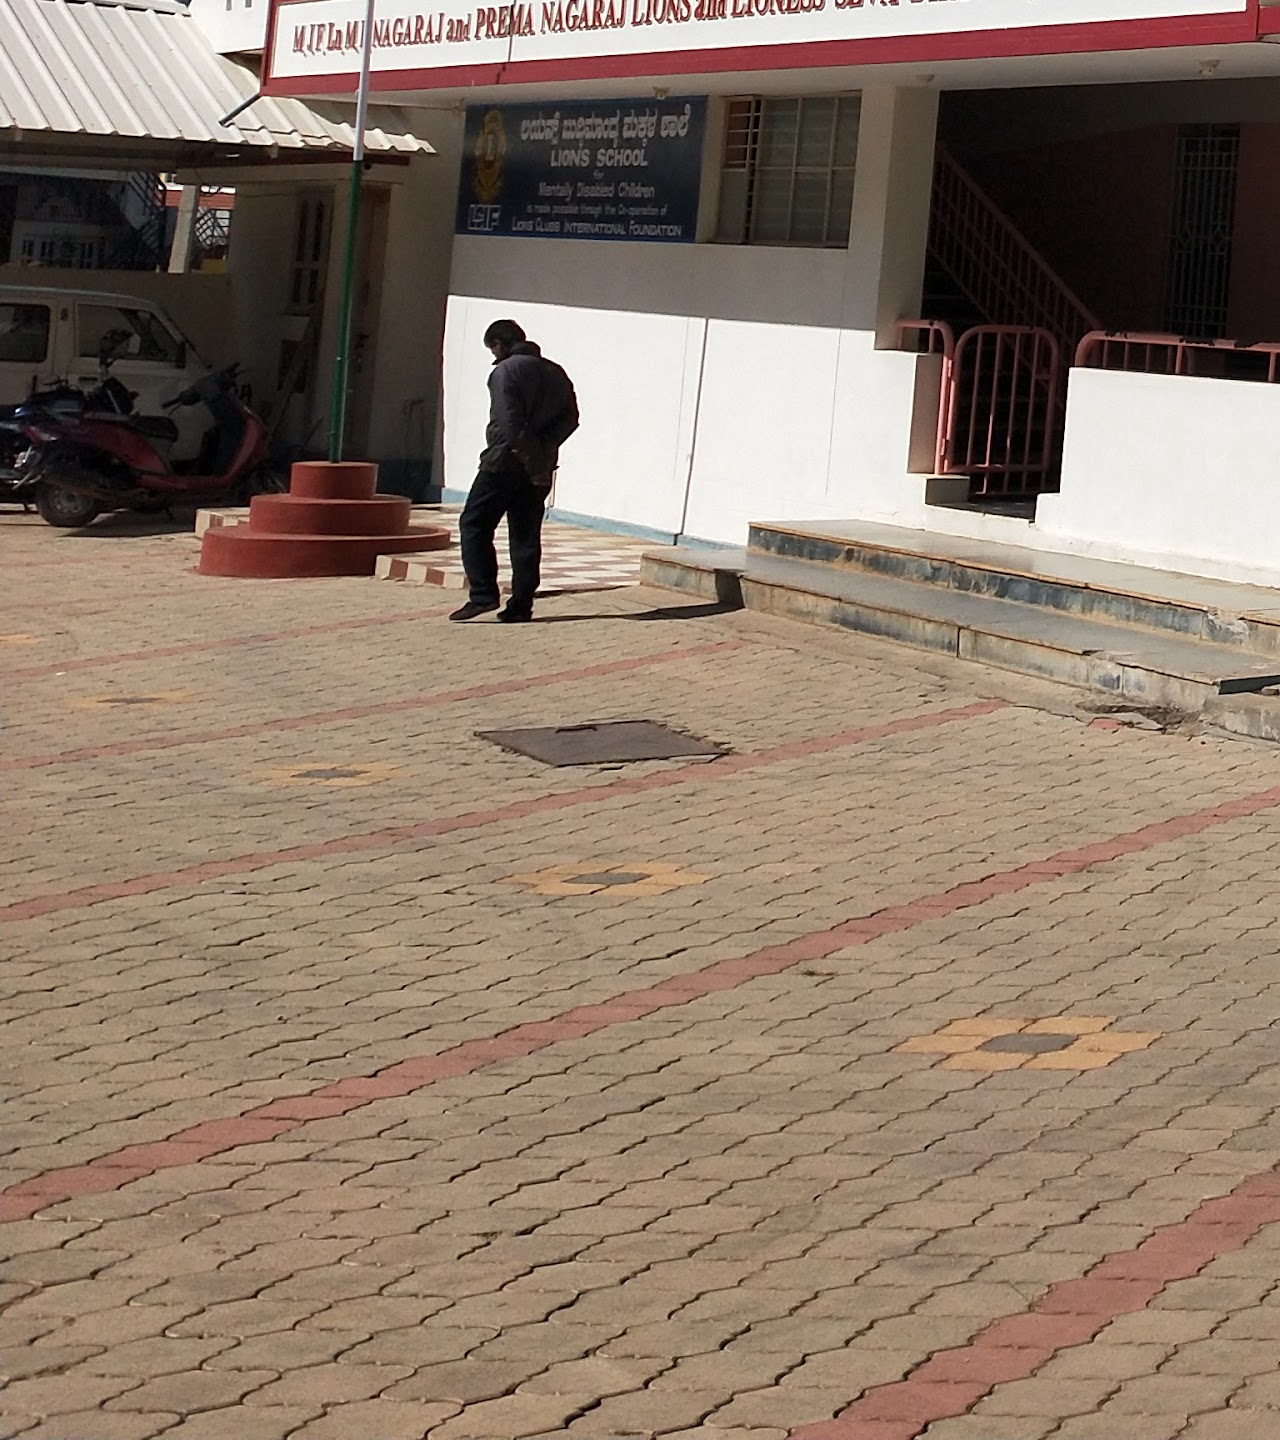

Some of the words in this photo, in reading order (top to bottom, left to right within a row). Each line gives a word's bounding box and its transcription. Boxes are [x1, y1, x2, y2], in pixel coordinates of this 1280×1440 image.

[372, 12, 445, 48] NAGARAJ
[446, 12, 472, 42] and
[474, 2, 535, 40] PREMA
[596, 149, 648, 167] SCHOOL
[538, 182, 573, 200] Mentally
[576, 182, 614, 198] Disabled
[618, 182, 655, 198] Children
